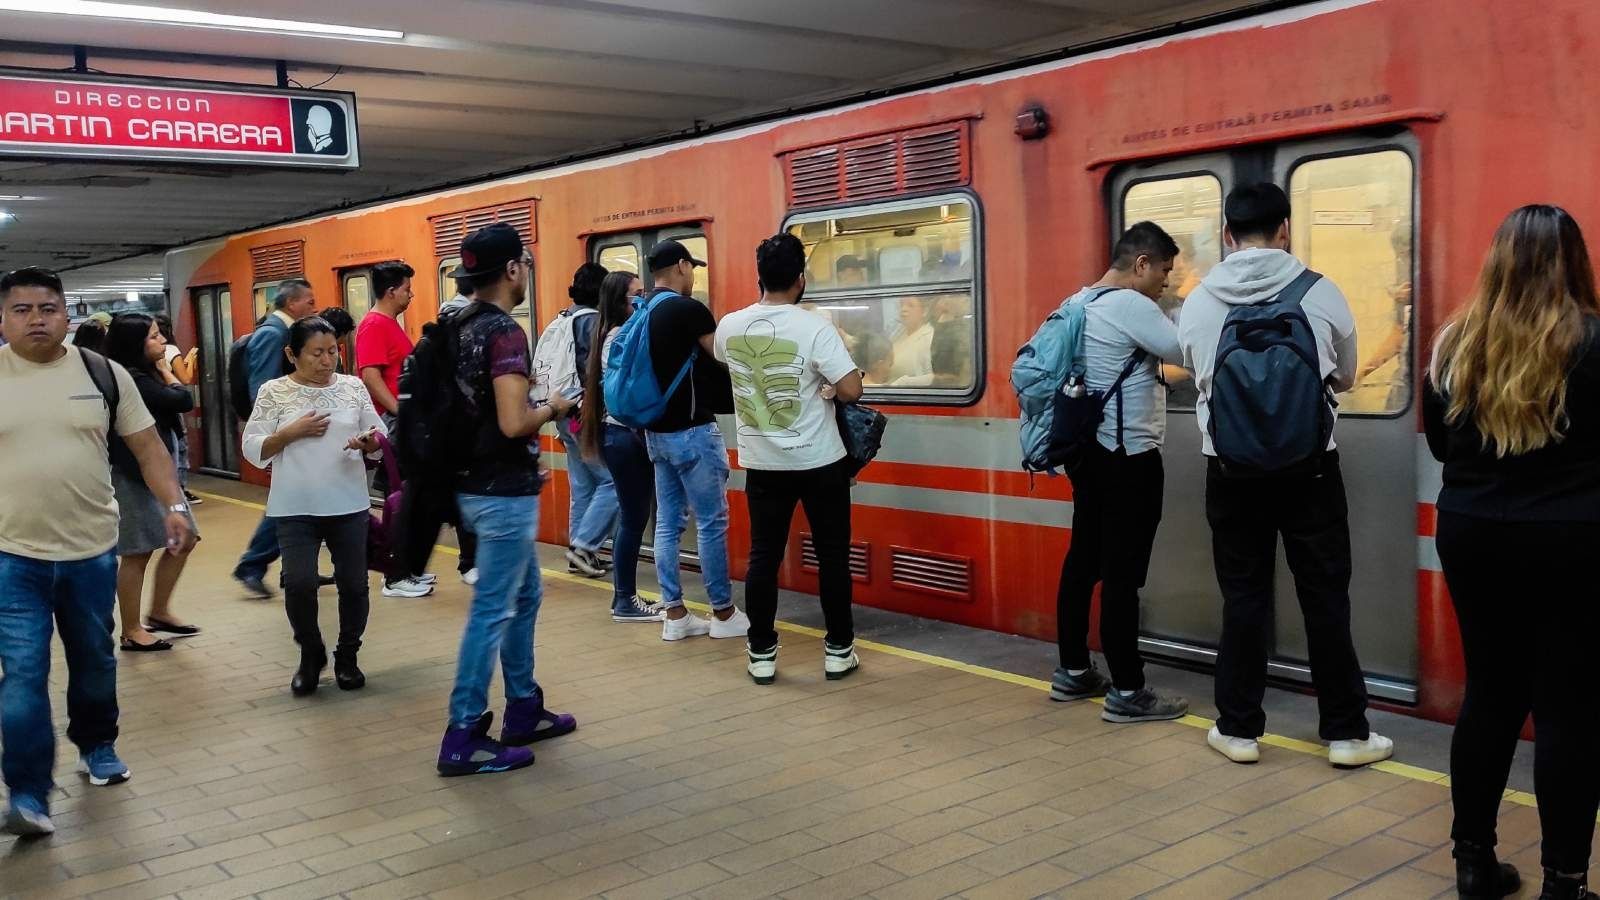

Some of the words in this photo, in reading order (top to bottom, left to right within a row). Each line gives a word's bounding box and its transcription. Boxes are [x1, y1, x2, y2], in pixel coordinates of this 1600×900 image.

[55, 89, 210, 113] DIRECCION
[0, 111, 112, 138] ARTIN
[128, 118, 283, 146] CARRERA
[1172, 126, 1190, 137] DE
